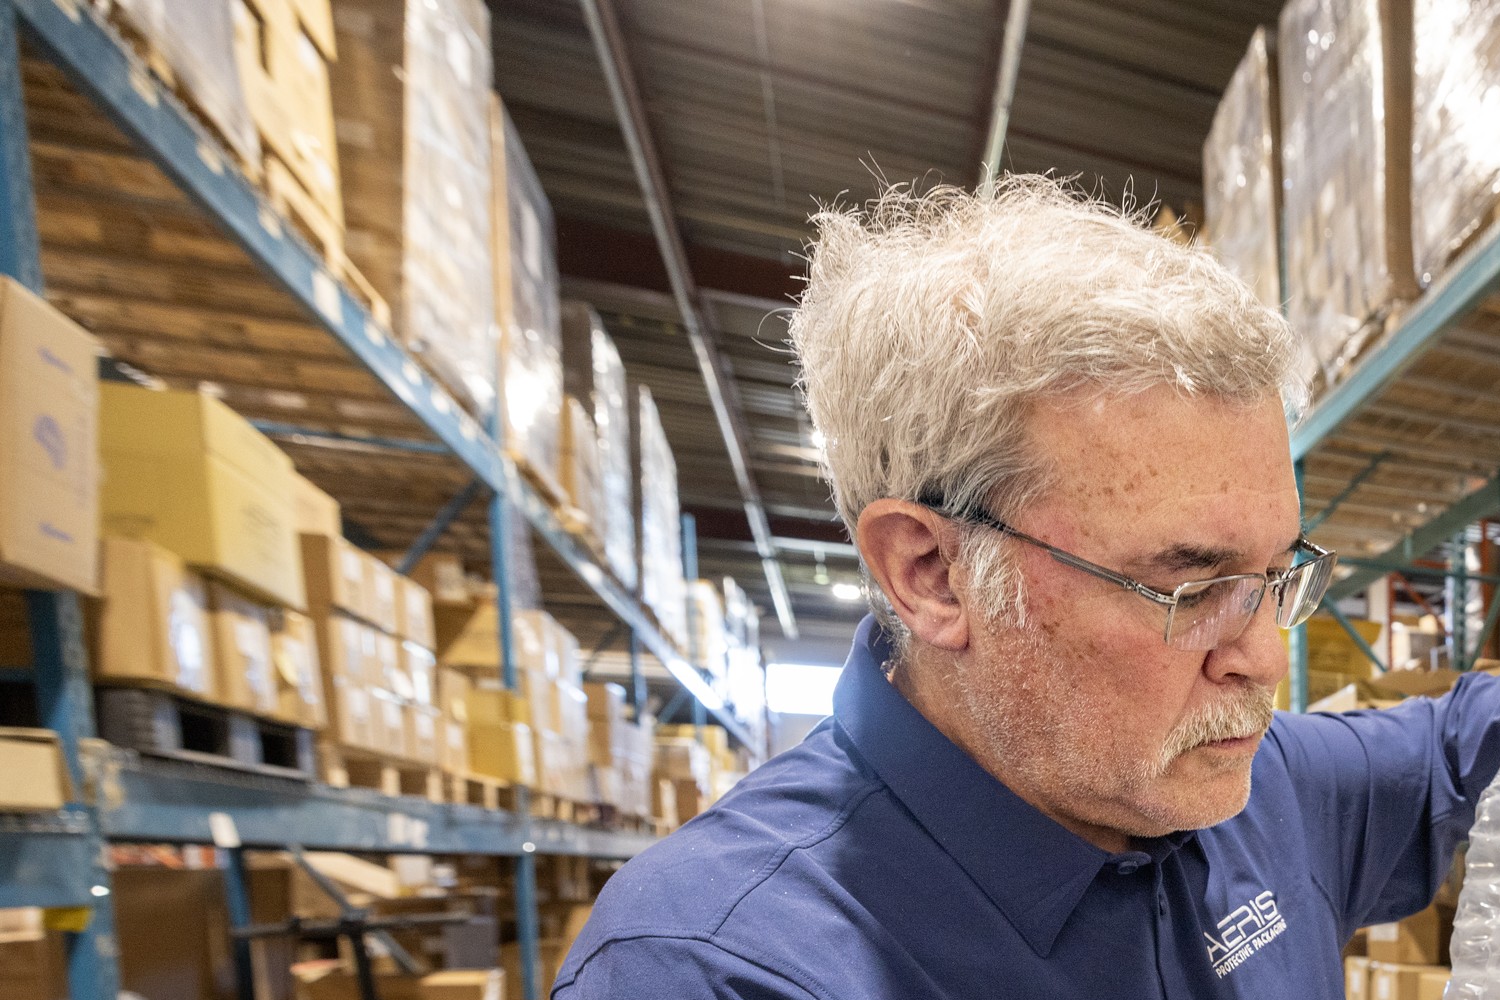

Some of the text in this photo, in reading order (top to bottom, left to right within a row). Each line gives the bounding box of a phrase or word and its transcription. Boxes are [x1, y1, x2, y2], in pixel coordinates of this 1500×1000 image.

[1203, 890, 1279, 963] AERIS
[1215, 918, 1287, 980] PROTECTIVE PACKAGING
